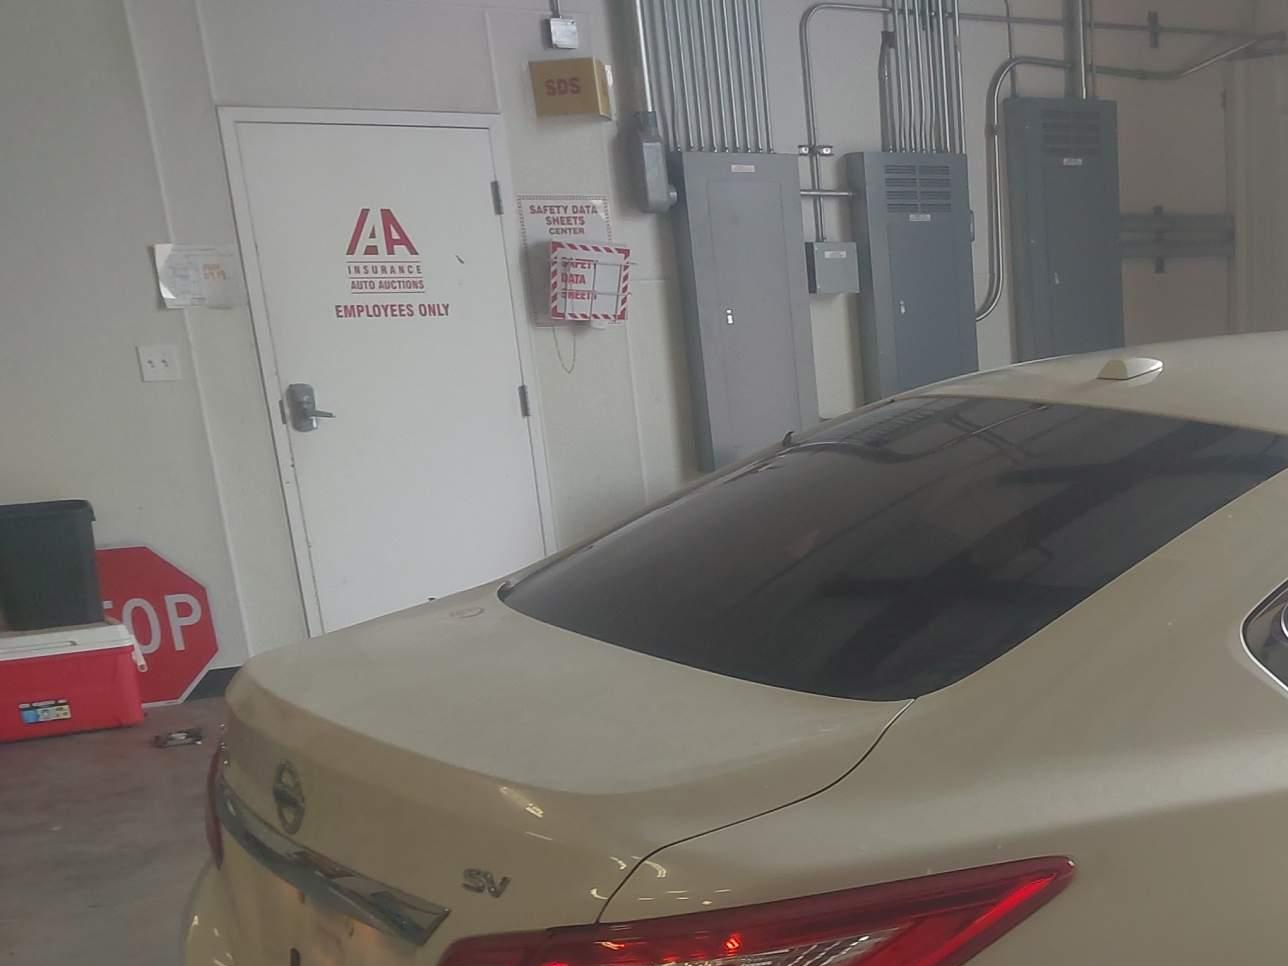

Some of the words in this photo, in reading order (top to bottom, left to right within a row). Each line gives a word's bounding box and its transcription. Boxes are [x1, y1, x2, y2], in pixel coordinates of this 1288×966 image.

[544, 77, 580, 96] SDS
[529, 205, 568, 215] SAFETY
[572, 205, 598, 214] DATA
[545, 216, 585, 225] SHEETS
[548, 227, 585, 235] CENTER
[347, 265, 422, 275] INSURANCE
[351, 280, 375, 290] AUTO
[378, 280, 424, 290] AUCTIONS
[335, 304, 414, 318] EMPLOYEES
[418, 304, 449, 316] ONLY
[103, 594, 202, 654] OP
[462, 868, 511, 898] SV
